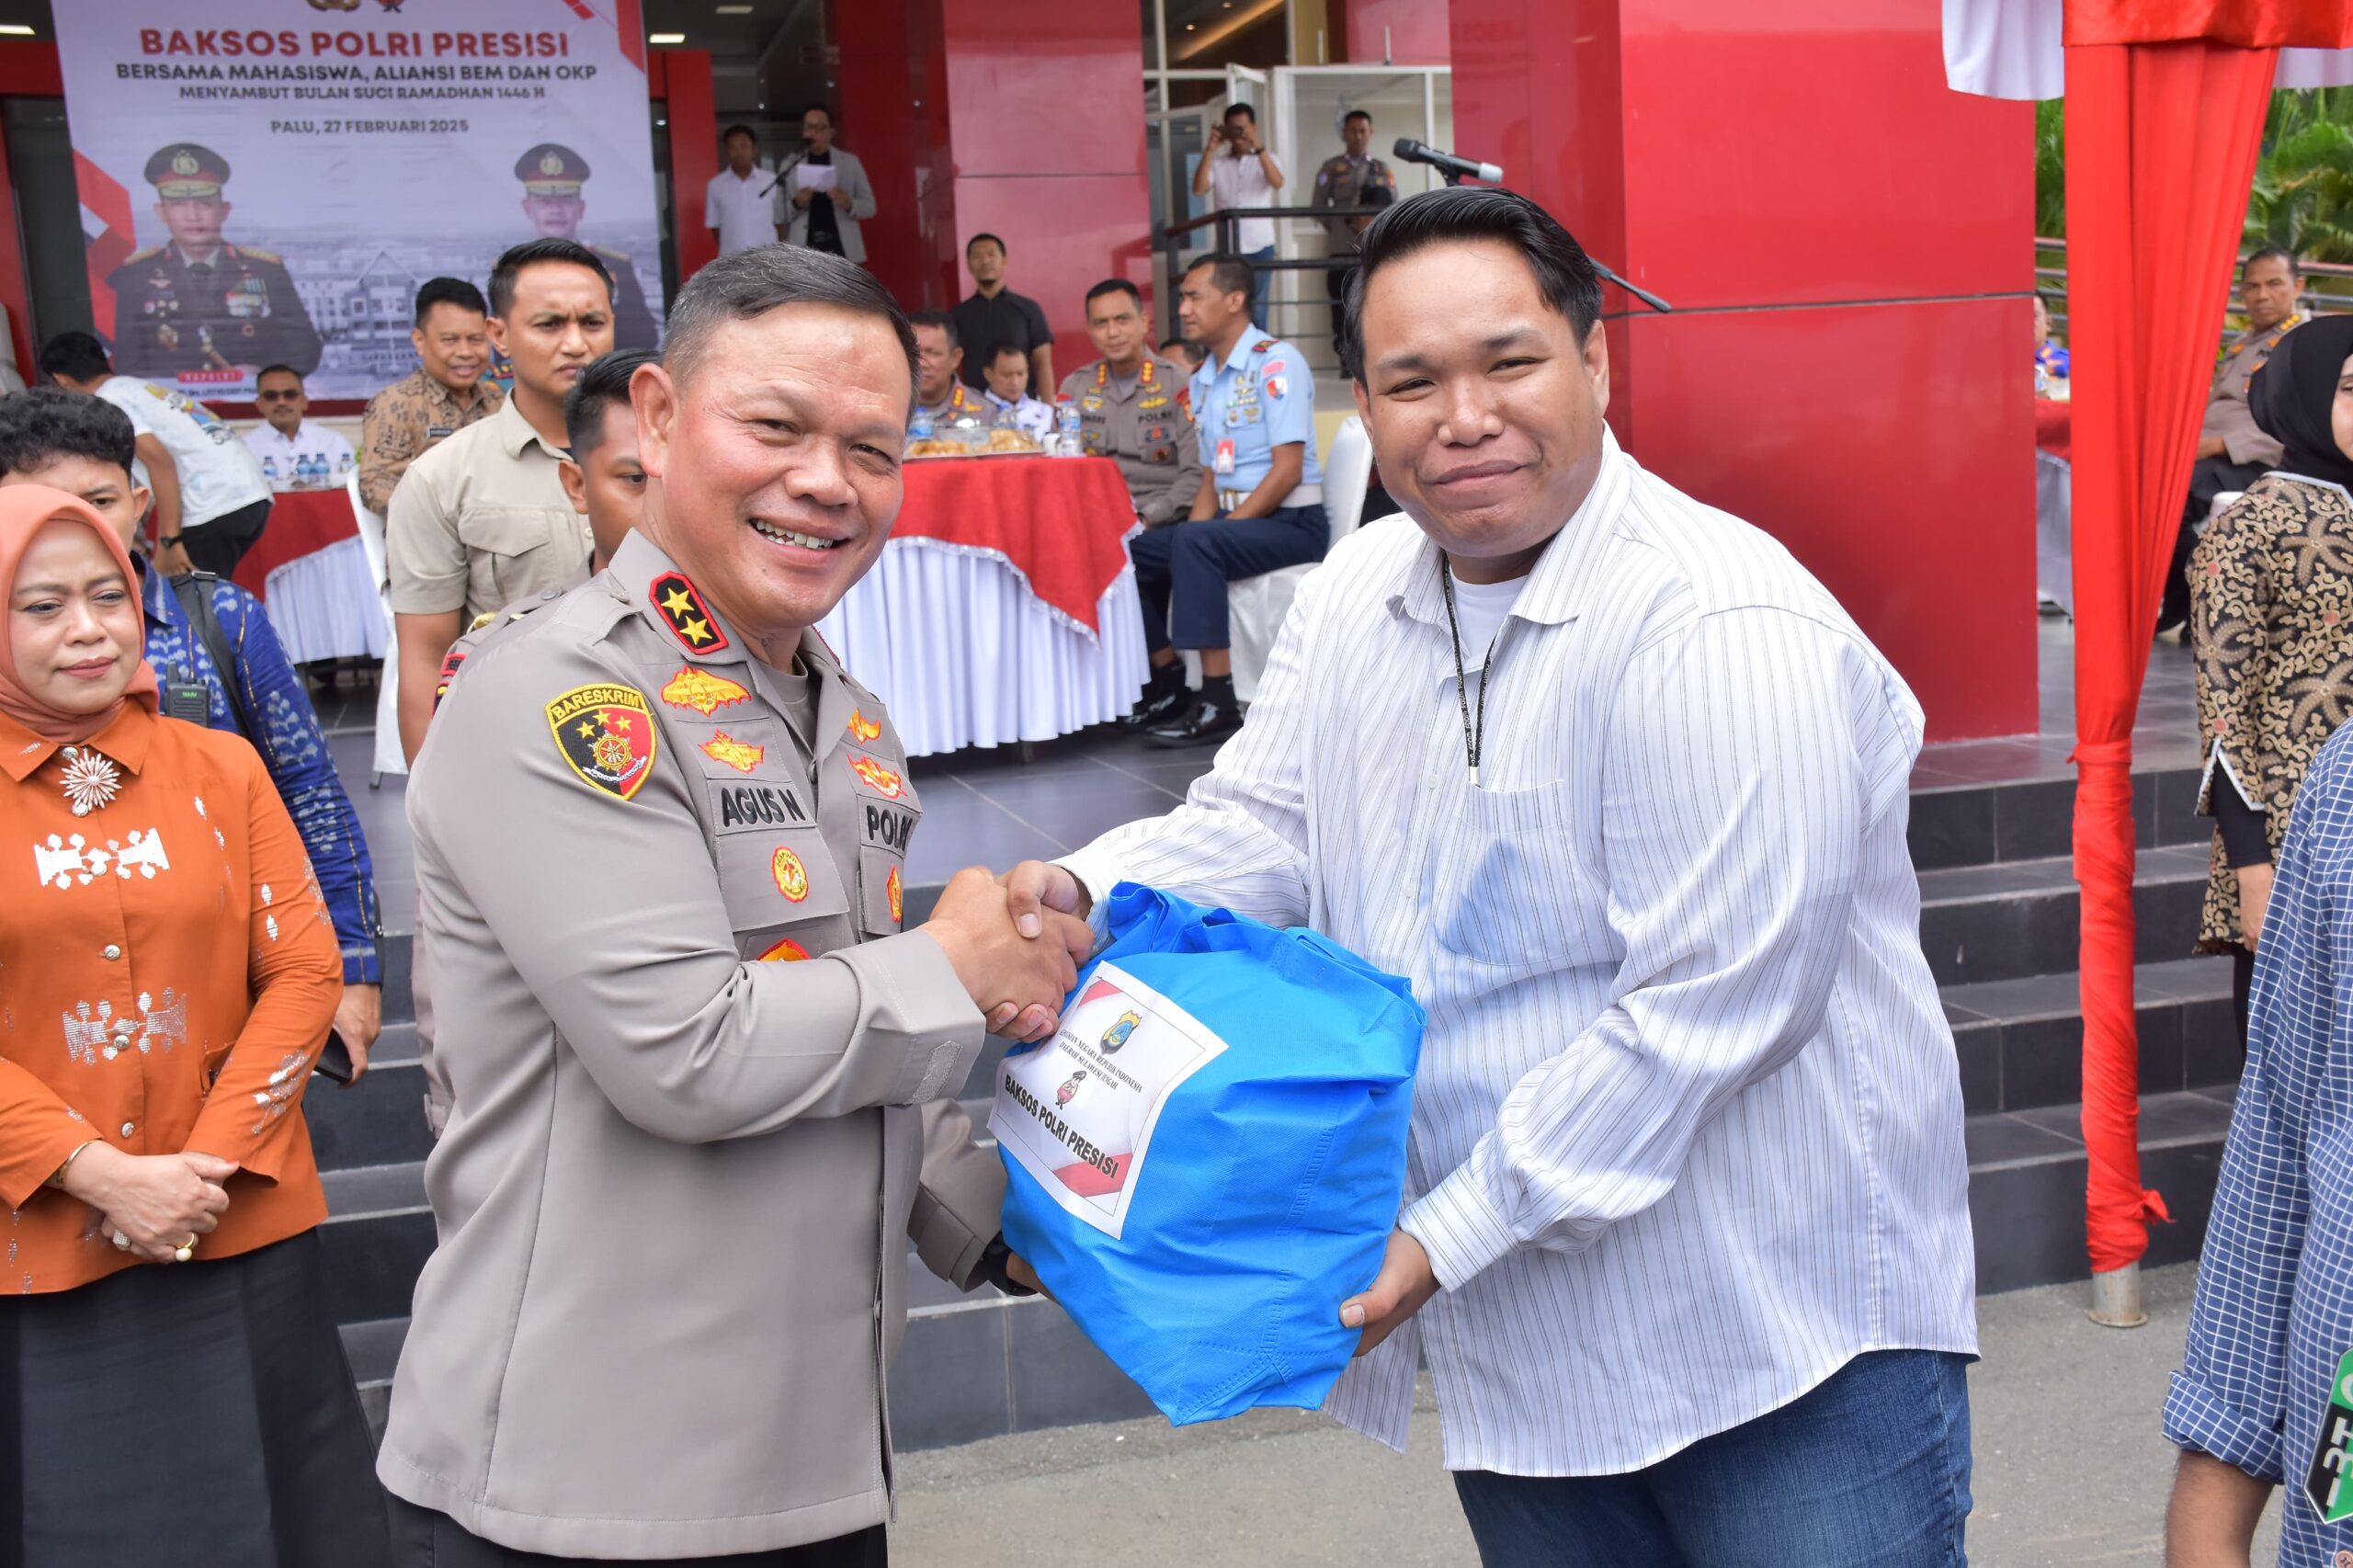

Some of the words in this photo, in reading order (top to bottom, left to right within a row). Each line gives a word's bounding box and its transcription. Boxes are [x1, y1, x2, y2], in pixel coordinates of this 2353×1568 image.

[140, 28, 301, 57] BAKSOS
[311, 31, 422, 57] POLRI
[432, 32, 569, 58] PRESISI
[116, 62, 224, 80] BERSAMA
[229, 64, 369, 83] MAHASISWA,
[374, 65, 455, 81] ALIANSI
[460, 65, 504, 80] BEM
[507, 65, 551, 80] DAN
[555, 65, 597, 80] OKP
[179, 86, 290, 99] MENYAMBUT
[293, 86, 349, 99] BULAN
[353, 86, 393, 99] SUCI
[396, 86, 494, 99] RAMADHAN
[496, 86, 530, 98] 1446
[533, 86, 545, 98] H
[270, 119, 320, 135] PALU,
[323, 119, 341, 133] 27
[345, 119, 426, 133] FEBRUARI
[428, 119, 469, 132] 2025
[551, 688, 640, 720] BARESKRIM
[721, 787, 785, 827] AGUS
[777, 789, 806, 822] N
[1059, 1040, 1080, 1060] DAERAH
[1077, 1055, 1103, 1078] SULAWESI
[1078, 1040, 1097, 1059] NEGARA
[1114, 1069, 1142, 1093] INDONESIA
[1005, 1073, 1040, 1118] BAKSOS
[1038, 1105, 1069, 1142] POLRI
[1066, 1130, 1120, 1179] PRESISI
